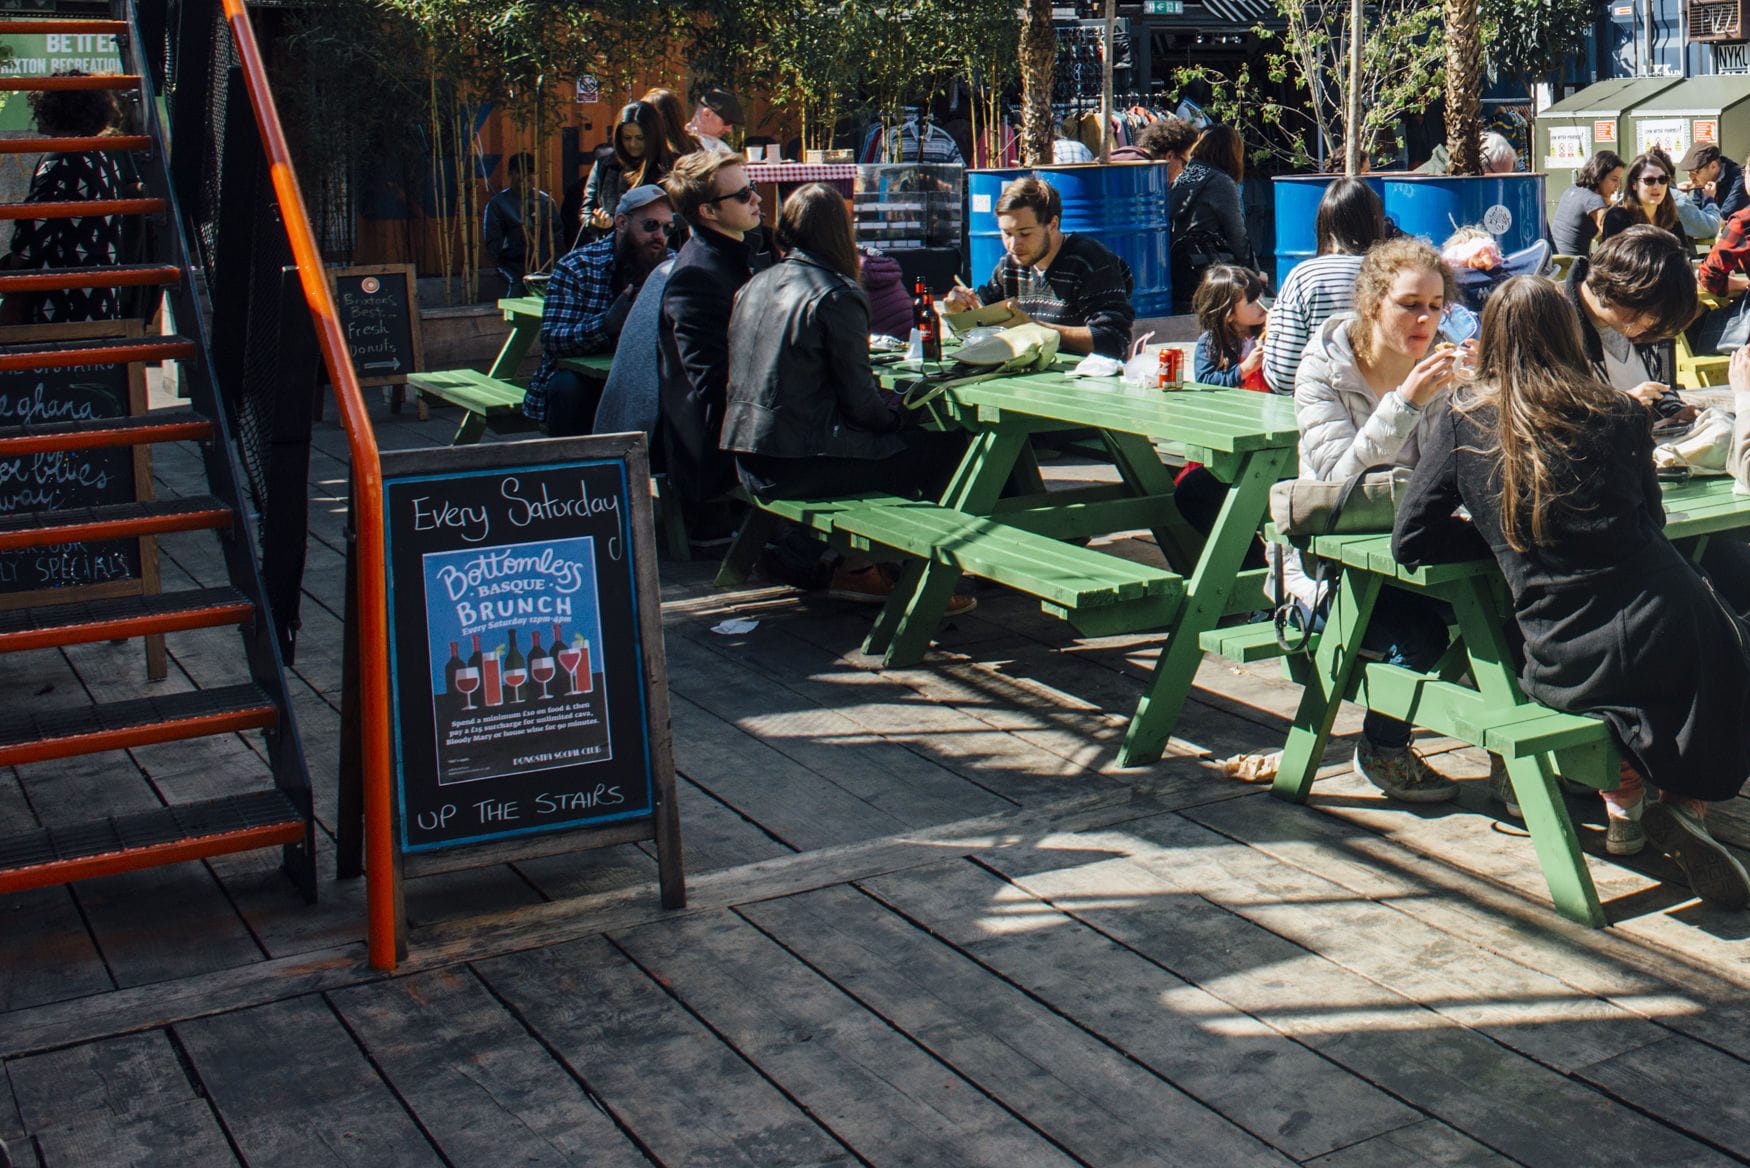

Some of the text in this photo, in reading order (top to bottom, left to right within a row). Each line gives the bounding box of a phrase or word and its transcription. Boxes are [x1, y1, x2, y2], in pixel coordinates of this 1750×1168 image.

[348, 319, 390, 339] Fresh
[411, 477, 623, 561] Every Saturday
[436, 548, 583, 602] Bottomless
[479, 579, 546, 597] BASQUE
[456, 596, 572, 628] BRUNCH
[462, 624, 487, 636] Every
[488, 617, 528, 630] Saturday
[449, 729, 463, 738] pay
[484, 720, 522, 732] surcharge
[536, 713, 573, 724] unlimited
[451, 718, 476, 728] Spend
[483, 712, 521, 723] minimum
[548, 705, 564, 713] food
[446, 736, 472, 746] Bloody
[473, 733, 492, 742] Mary
[526, 725, 544, 734] wine
[418, 783, 625, 830] UP THE STAIRS
